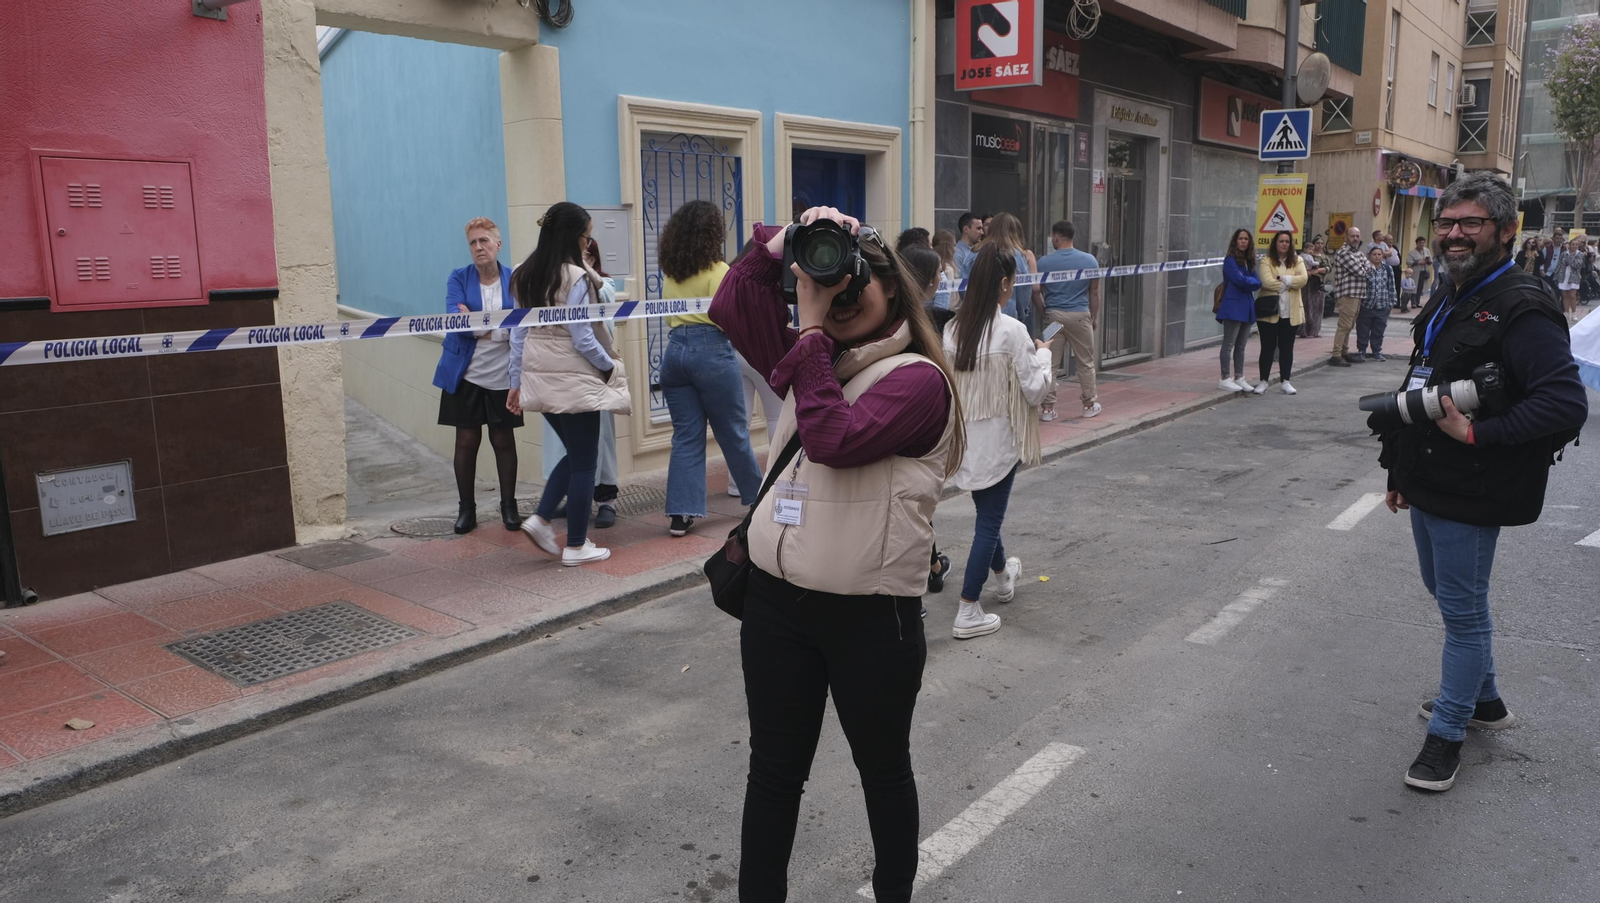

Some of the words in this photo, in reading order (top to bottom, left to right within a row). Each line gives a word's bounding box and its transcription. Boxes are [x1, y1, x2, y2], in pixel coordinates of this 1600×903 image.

[1046, 44, 1080, 76] SÁEZ
[960, 64, 992, 80] JOSÉ
[995, 62, 1029, 77] SÁEZ
[1262, 186, 1303, 196] ATENCIÓN
[1258, 237, 1270, 245] CERA
[538, 308, 567, 323] POLICIA
[568, 306, 590, 320] LOCAL
[645, 301, 669, 315] POLICIA
[669, 300, 688, 313] LOCAL
[408, 317, 443, 333] POLICIA
[444, 315, 471, 330] LOCAL
[248, 327, 291, 344] POLICIA
[293, 325, 325, 341] LOCAL
[44, 340, 98, 359] POLICIA
[102, 337, 143, 355] LOCAL
[53, 471, 114, 488] CONTADOR
[49, 514, 82, 528] LLAVE
[85, 510, 99, 522] DE
[101, 507, 127, 519] PASO
